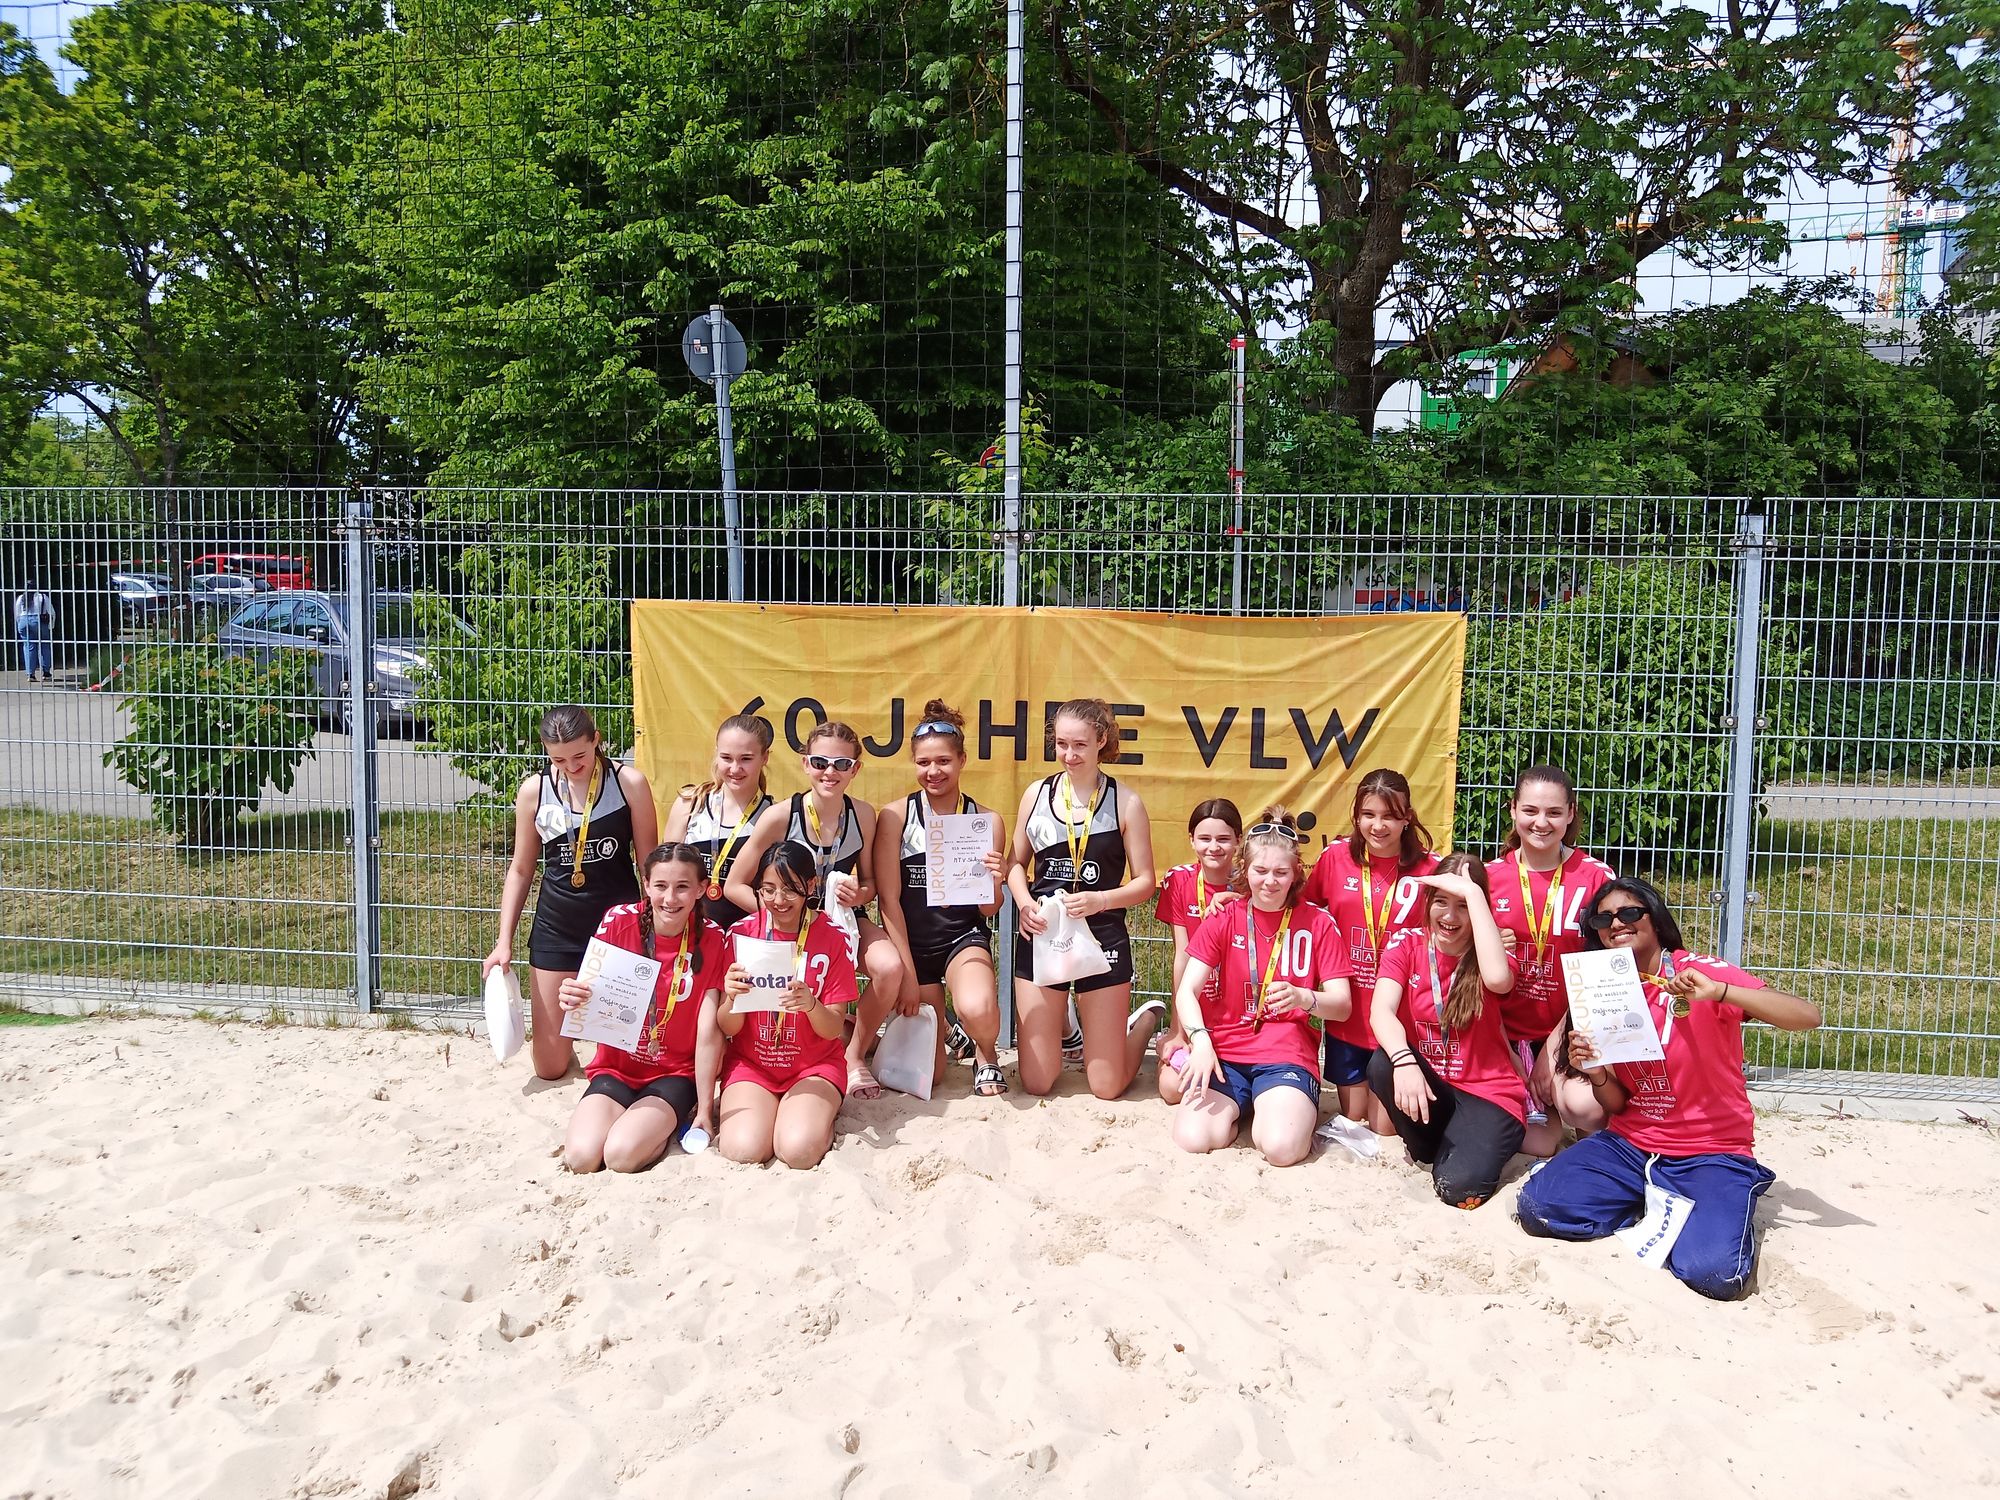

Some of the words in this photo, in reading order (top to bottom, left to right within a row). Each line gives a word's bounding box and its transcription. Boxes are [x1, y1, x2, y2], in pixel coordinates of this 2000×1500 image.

[862, 697, 1145, 765] JHE
[1181, 706, 1381, 770] VLW
[930, 819, 946, 902] URKUNDE
[1394, 875, 1419, 925] 9
[1547, 885, 1587, 938] 14
[796, 951, 830, 999] 13
[1280, 928, 1313, 978] 10
